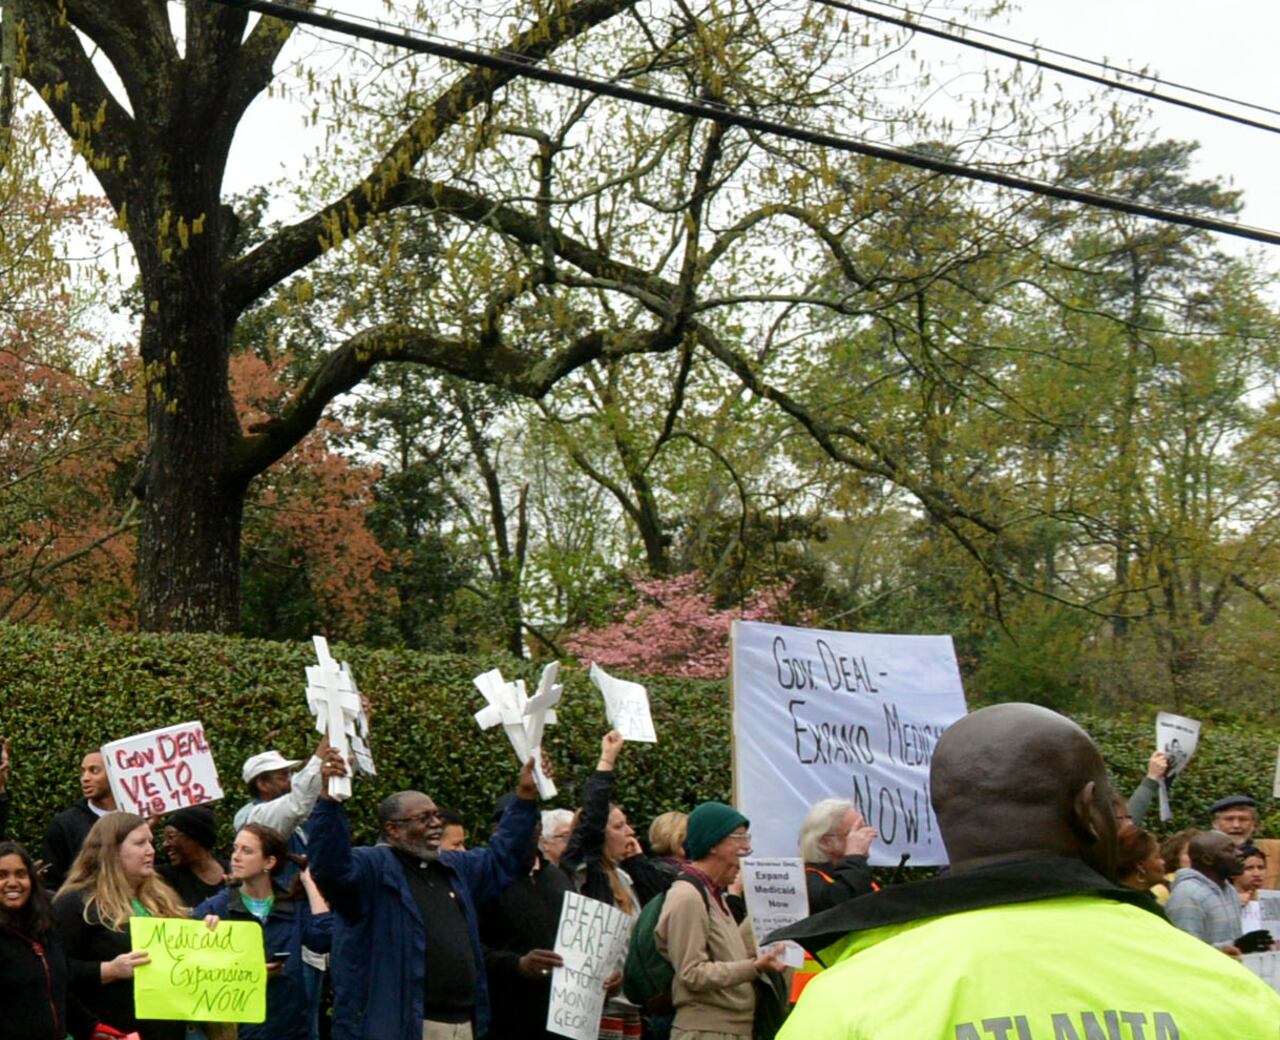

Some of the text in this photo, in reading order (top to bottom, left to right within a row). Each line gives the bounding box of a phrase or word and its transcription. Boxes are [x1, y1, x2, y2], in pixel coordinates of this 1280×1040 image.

[790, 700, 874, 764] EXPAND
[120, 760, 192, 804] VETO
[754, 885, 795, 895] Medicaid
[755, 871, 789, 881] Expand
[140, 921, 244, 960] Medicaid
[170, 954, 260, 995] Expansion
[191, 984, 258, 1015] NOW
